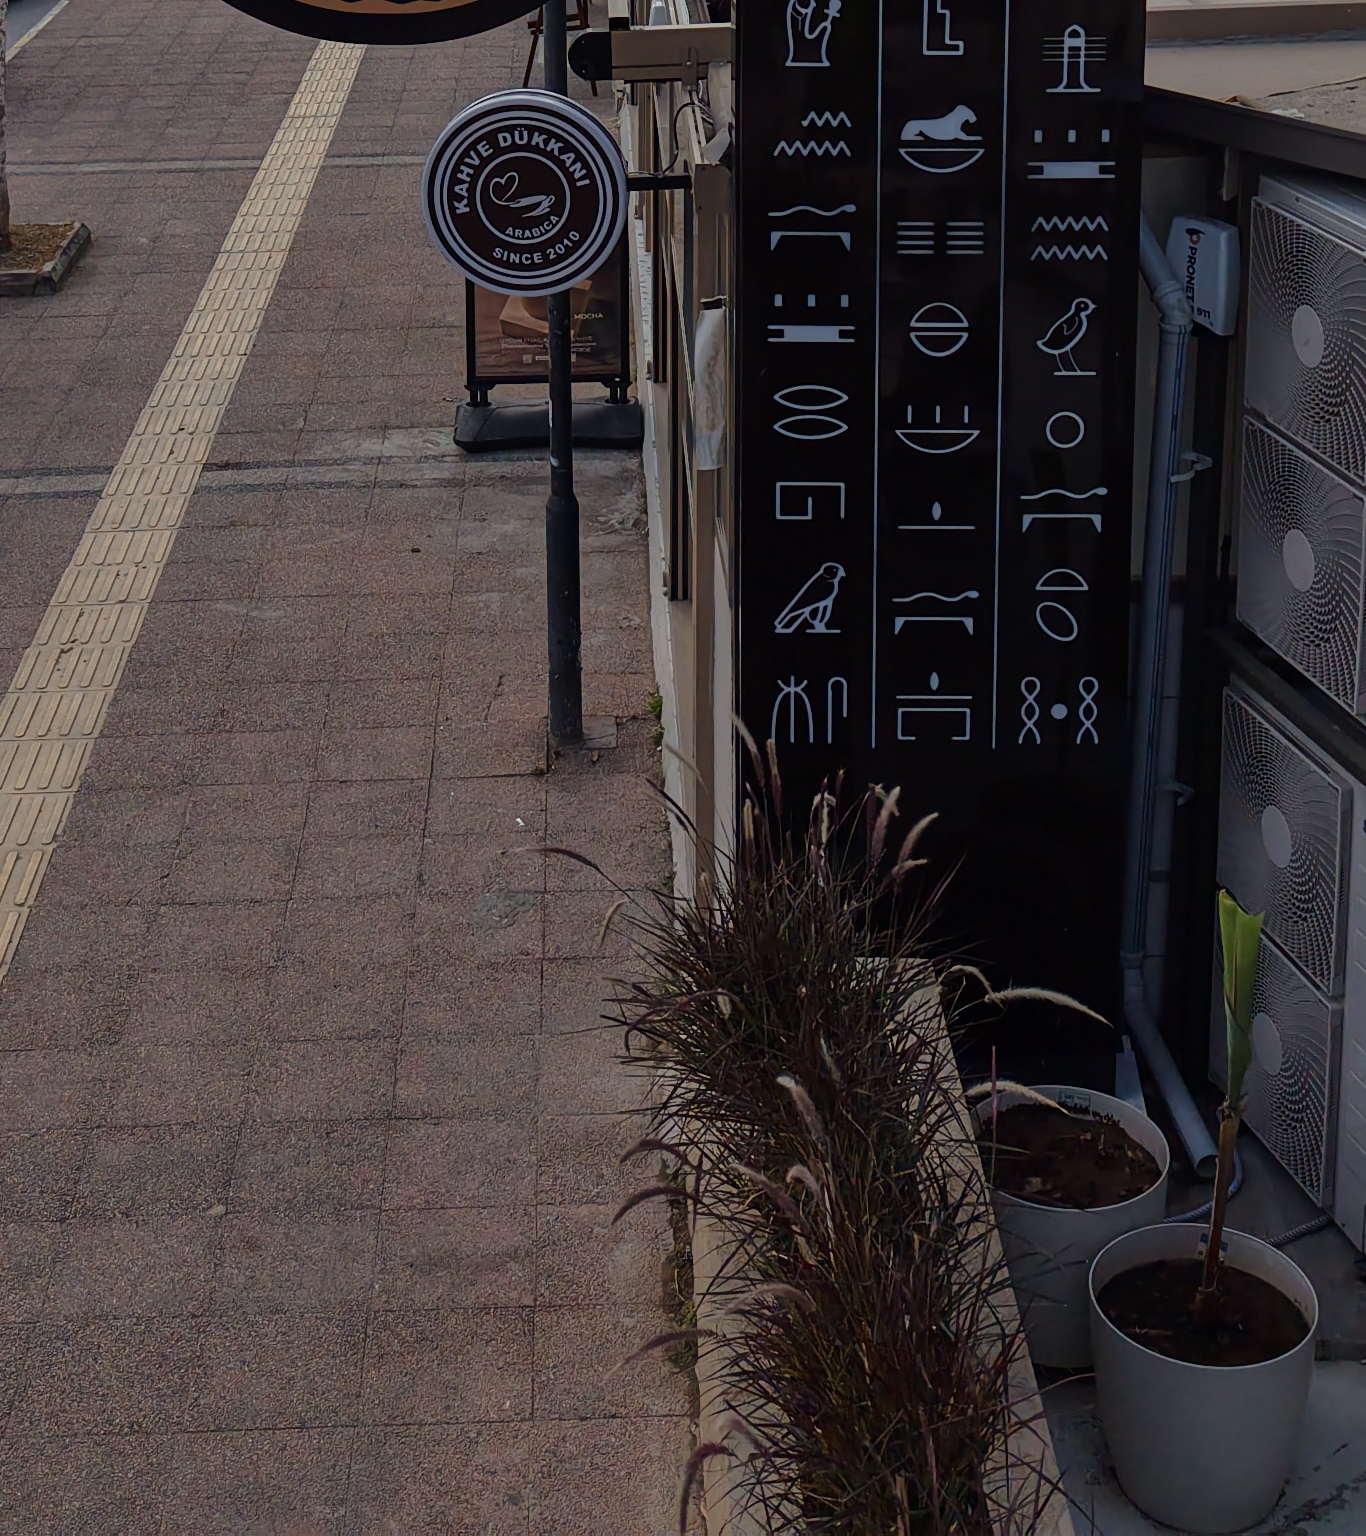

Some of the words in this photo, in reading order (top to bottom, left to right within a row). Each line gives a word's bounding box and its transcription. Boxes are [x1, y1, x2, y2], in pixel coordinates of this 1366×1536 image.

[453, 140, 494, 215] KAHVE
[497, 127, 591, 187] DÜKKANI
[492, 246, 543, 264] SINCE
[546, 230, 580, 260] 2010
[505, 215, 560, 239] ARABICA
[1185, 246, 1198, 303] PRONET
